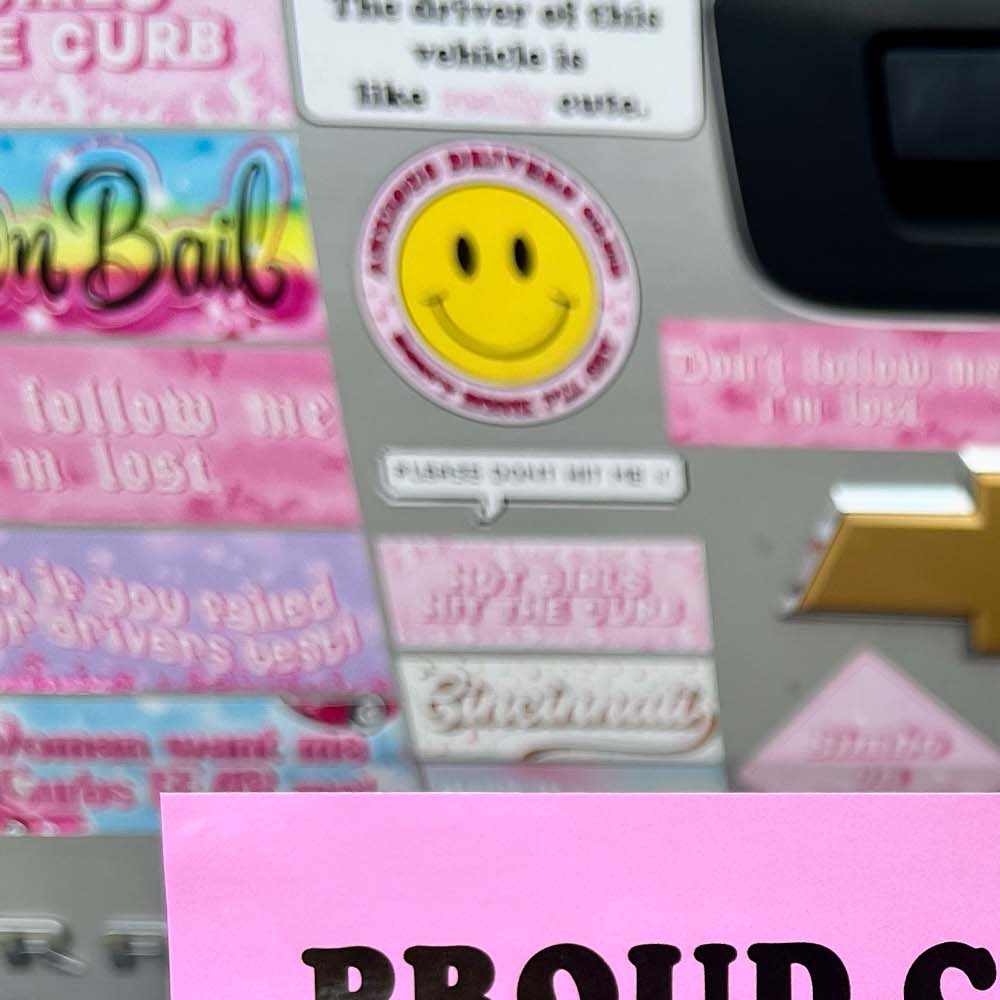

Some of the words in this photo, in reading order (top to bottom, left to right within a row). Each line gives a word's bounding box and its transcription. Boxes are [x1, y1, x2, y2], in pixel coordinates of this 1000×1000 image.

[50, 14, 236, 74] CURB
[352, 79, 427, 110] like
[62, 160, 290, 310] Bail
[20, 374, 219, 438] follow
[242, 388, 337, 441] me
[92, 436, 224, 494] lost
[92, 574, 193, 627] you
[45, 606, 236, 676] drivers
